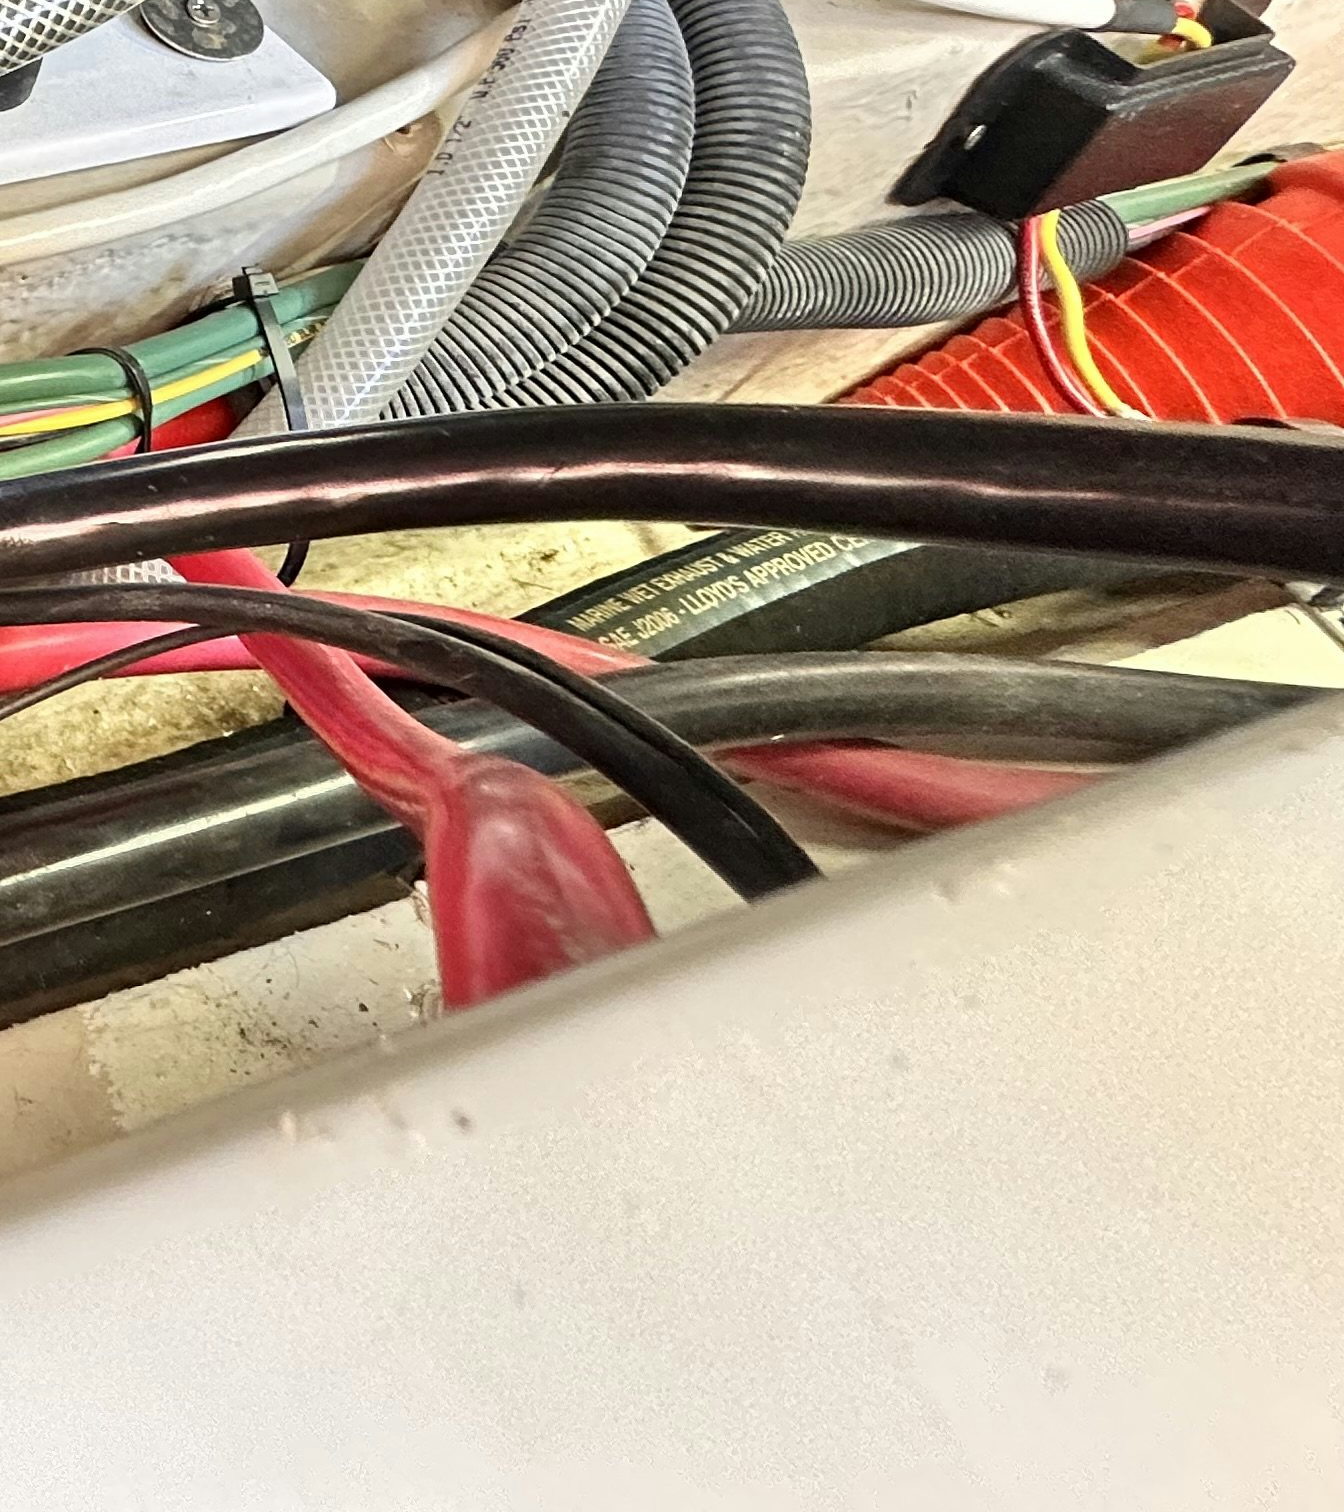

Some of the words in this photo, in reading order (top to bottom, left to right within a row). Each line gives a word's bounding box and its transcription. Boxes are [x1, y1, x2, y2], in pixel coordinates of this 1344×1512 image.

[566, 594, 632, 633] MARINE
[624, 583, 657, 611] WET
[653, 556, 723, 592] EXHAUST
[732, 529, 789, 561] WATER
[634, 607, 681, 642] J2006
[745, 539, 838, 587] APPROVED
